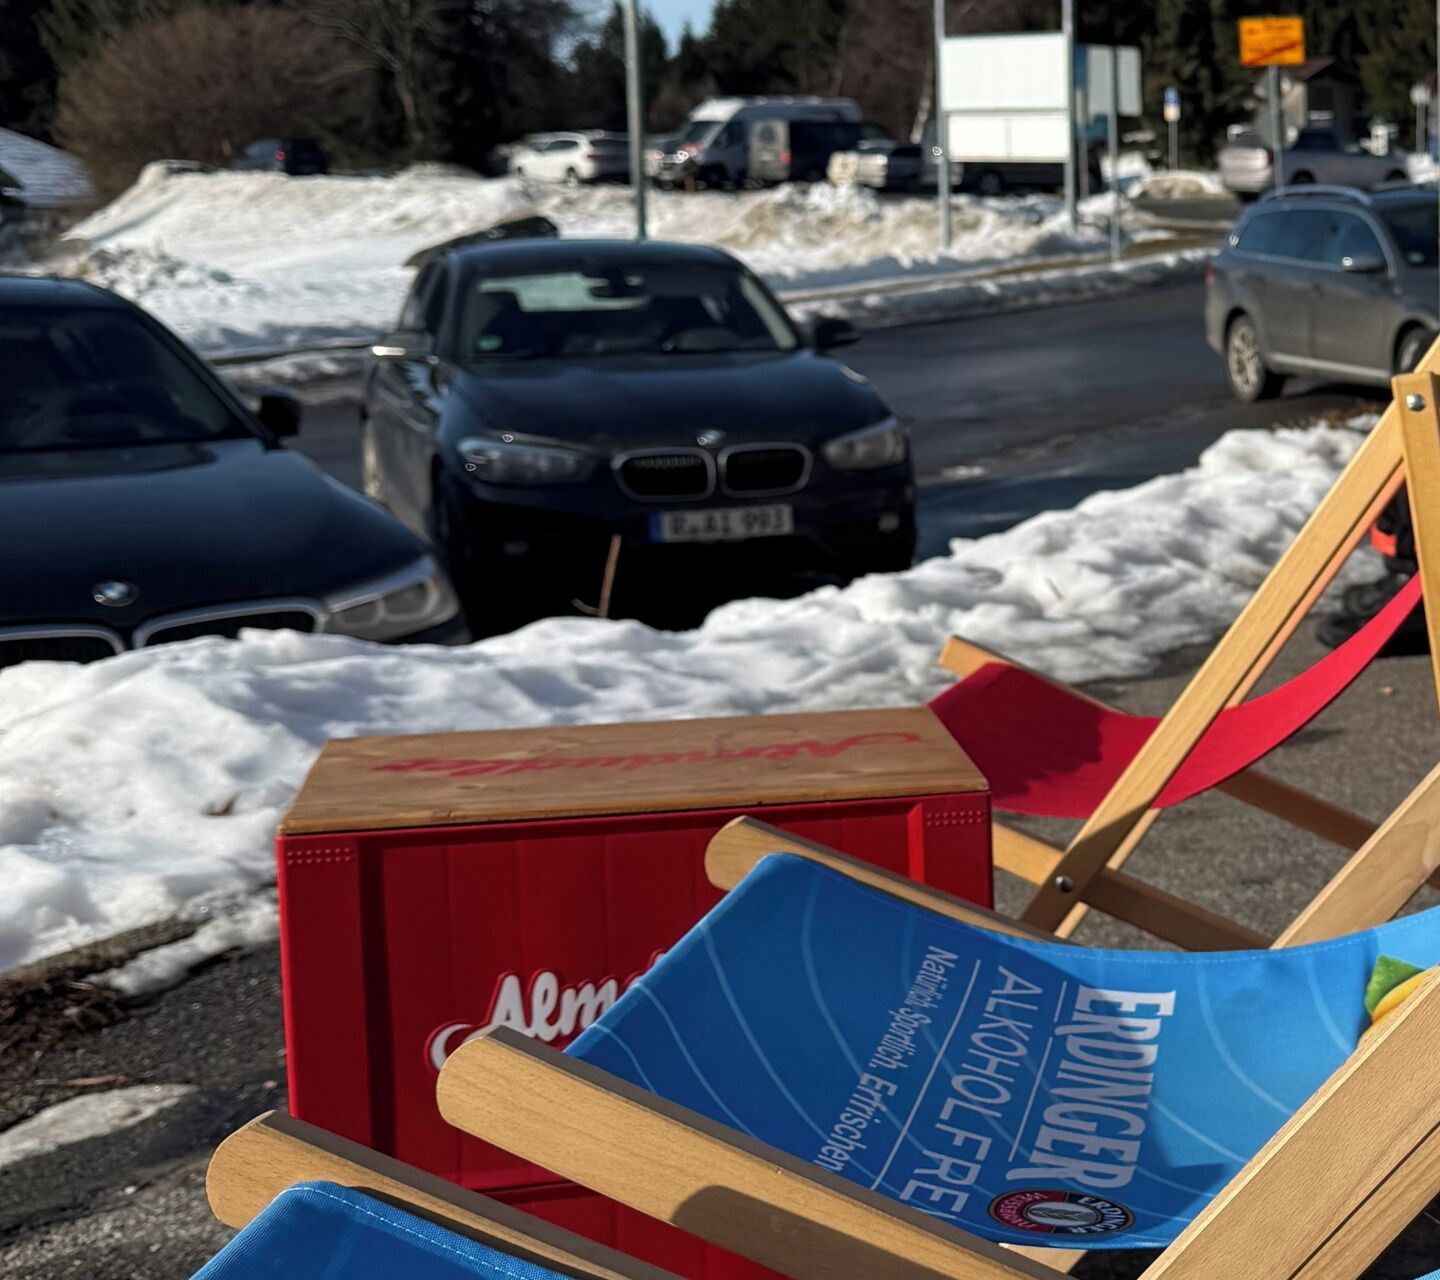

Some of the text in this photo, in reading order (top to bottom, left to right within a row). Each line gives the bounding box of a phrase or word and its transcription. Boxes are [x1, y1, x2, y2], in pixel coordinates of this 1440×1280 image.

[430, 953, 665, 1070] Alm
[813, 1072, 898, 1173] Erfrischen
[1006, 985, 1176, 1188] ERDINGER
